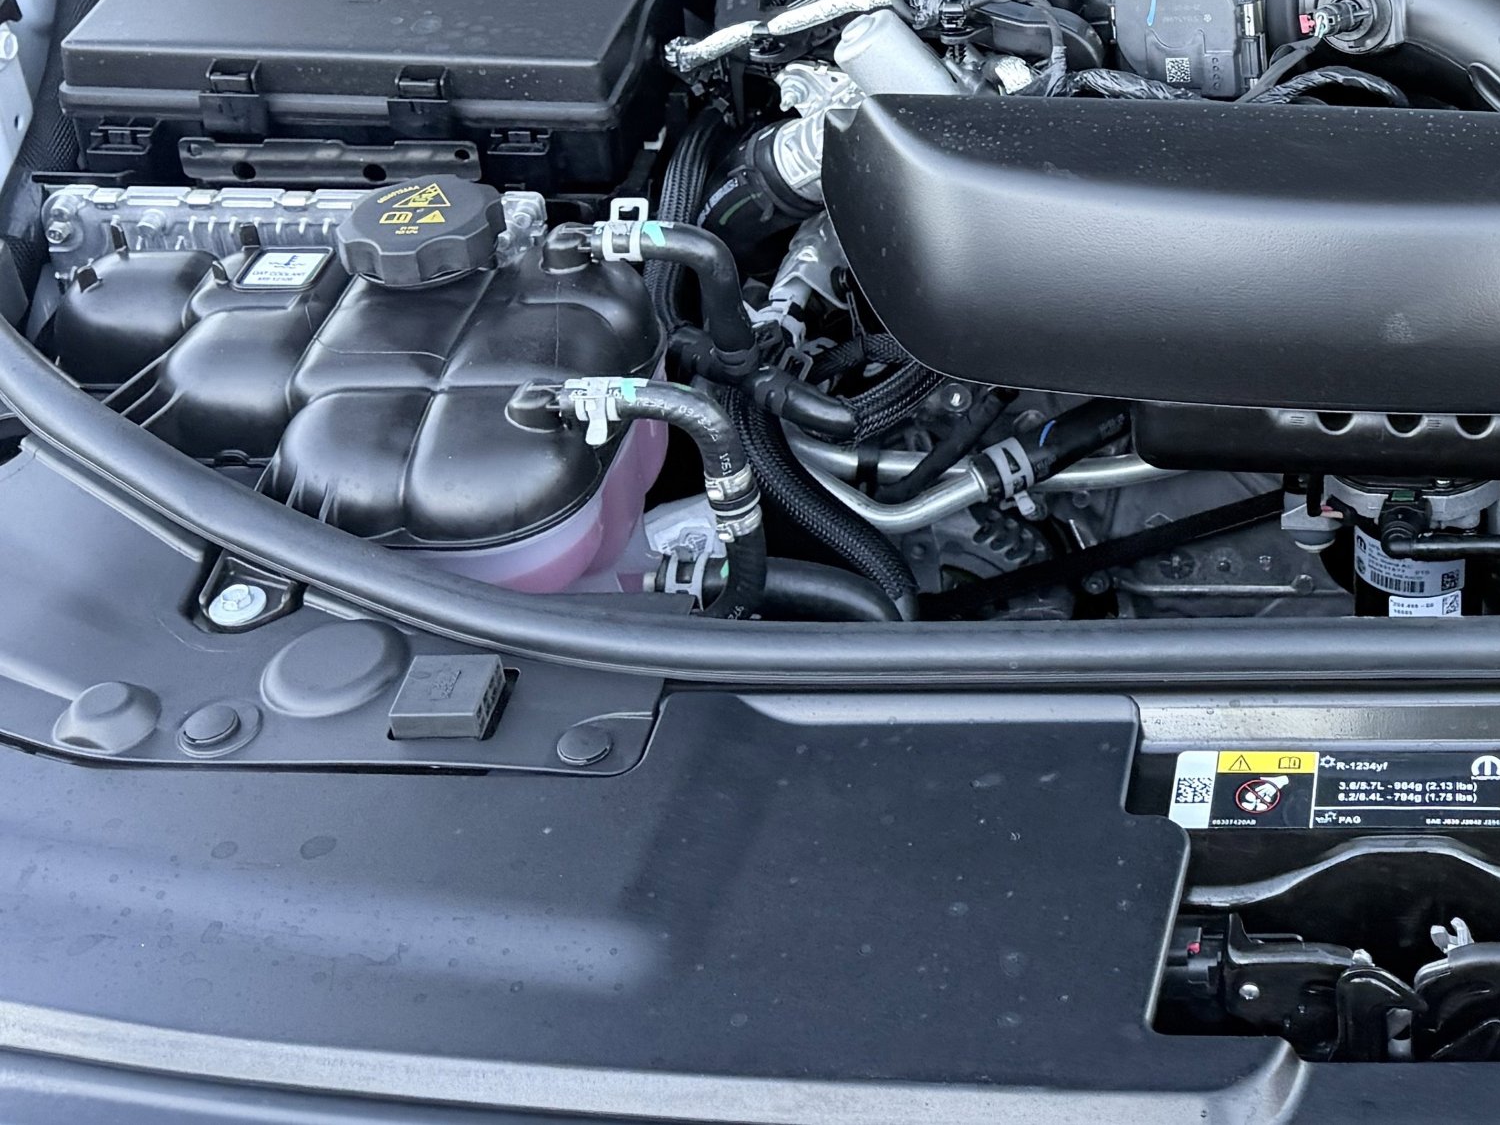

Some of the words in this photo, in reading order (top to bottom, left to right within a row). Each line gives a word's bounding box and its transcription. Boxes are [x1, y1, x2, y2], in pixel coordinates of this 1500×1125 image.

[1336, 762, 1388, 771] R-1234yf
[1339, 782, 1385, 790] 3.6/5.7L
[1426, 782, 1453, 792] (2.13
[1456, 782, 1478, 792] lbs)
[1338, 792, 1384, 801] 6.2/6.4L
[1425, 792, 1453, 803] (1.75
[1455, 792, 1478, 803] lbs)
[1338, 816, 1361, 824] PAG
